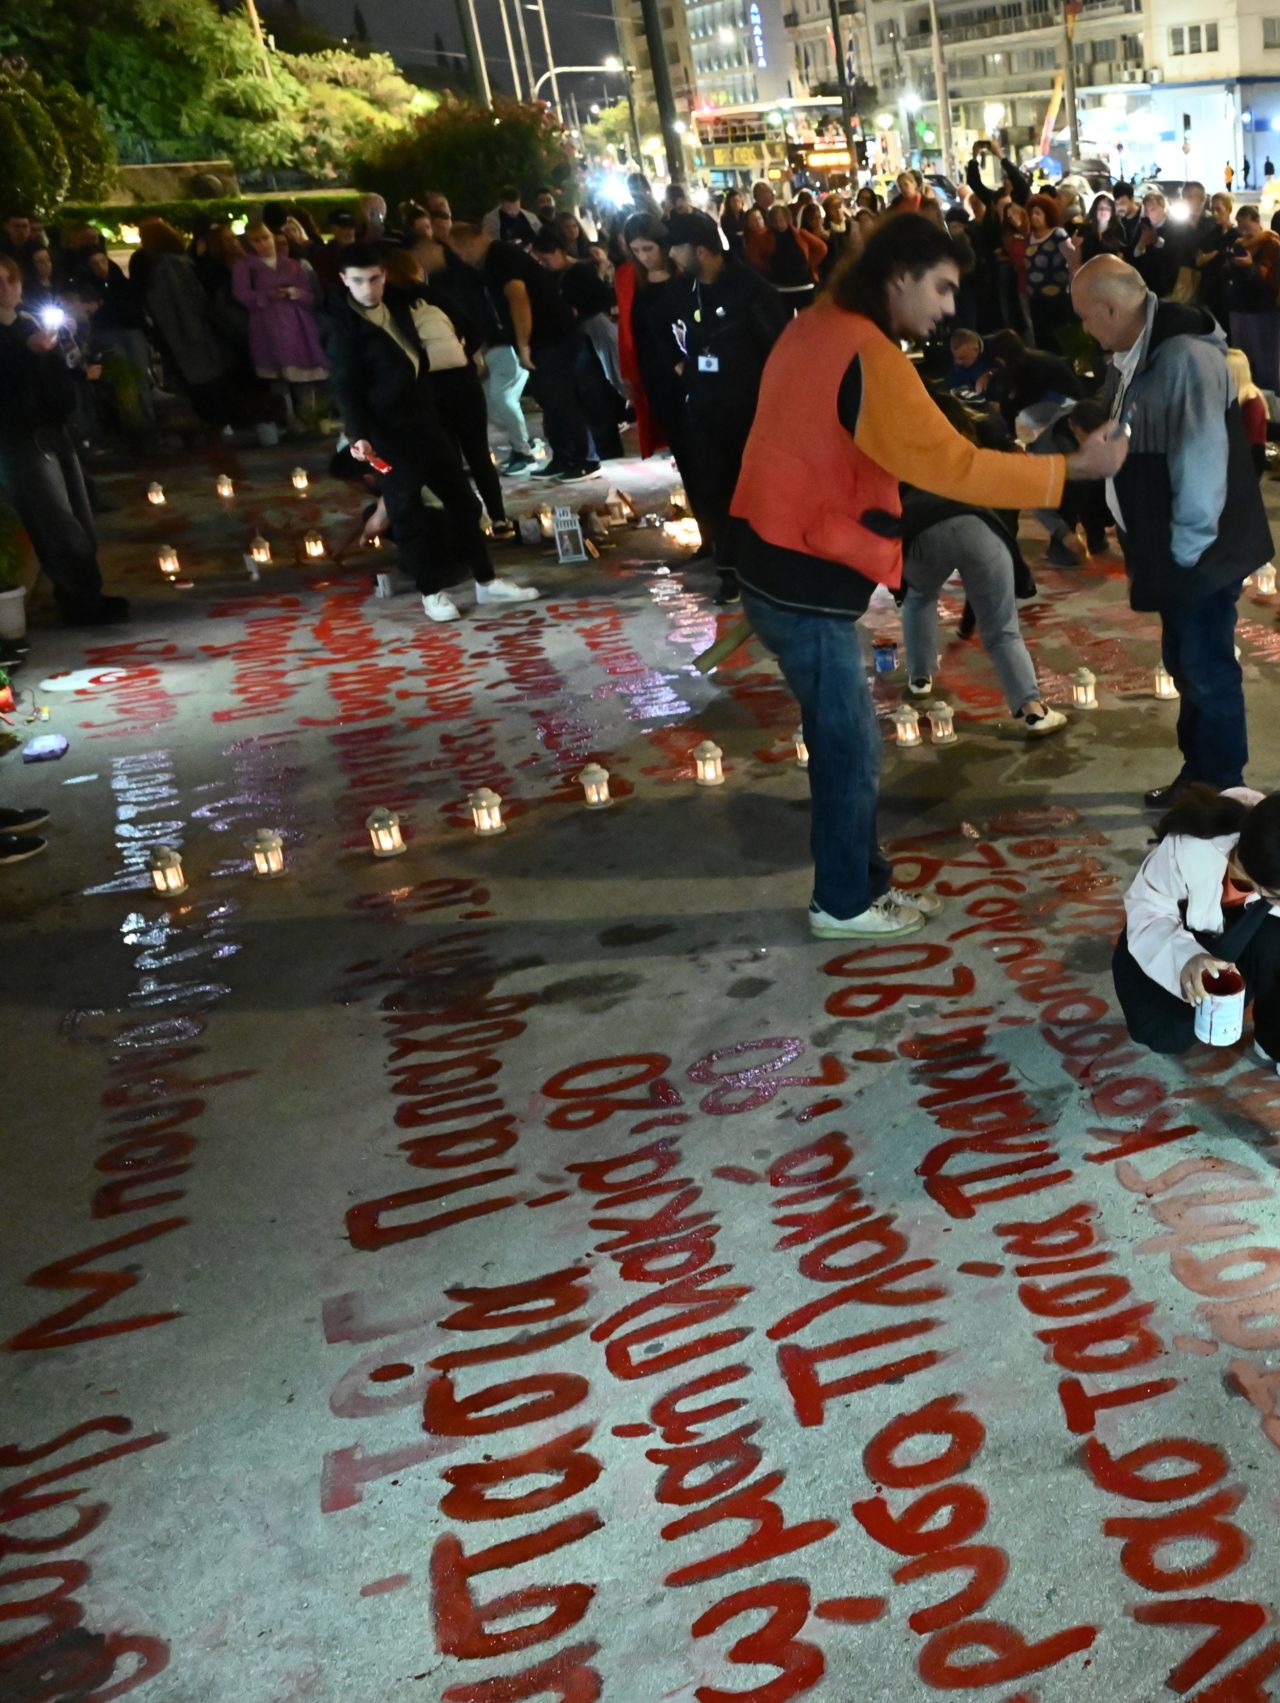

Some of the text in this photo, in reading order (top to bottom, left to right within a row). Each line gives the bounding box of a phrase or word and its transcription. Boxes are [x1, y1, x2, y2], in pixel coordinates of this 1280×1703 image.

[750, 2, 767, 68] AMALIA
[823, 943, 976, 1017] 20
[540, 1052, 684, 1132] 20
[686, 1036, 848, 1115] 20
[815, 1393, 1098, 1703] ρύσα
